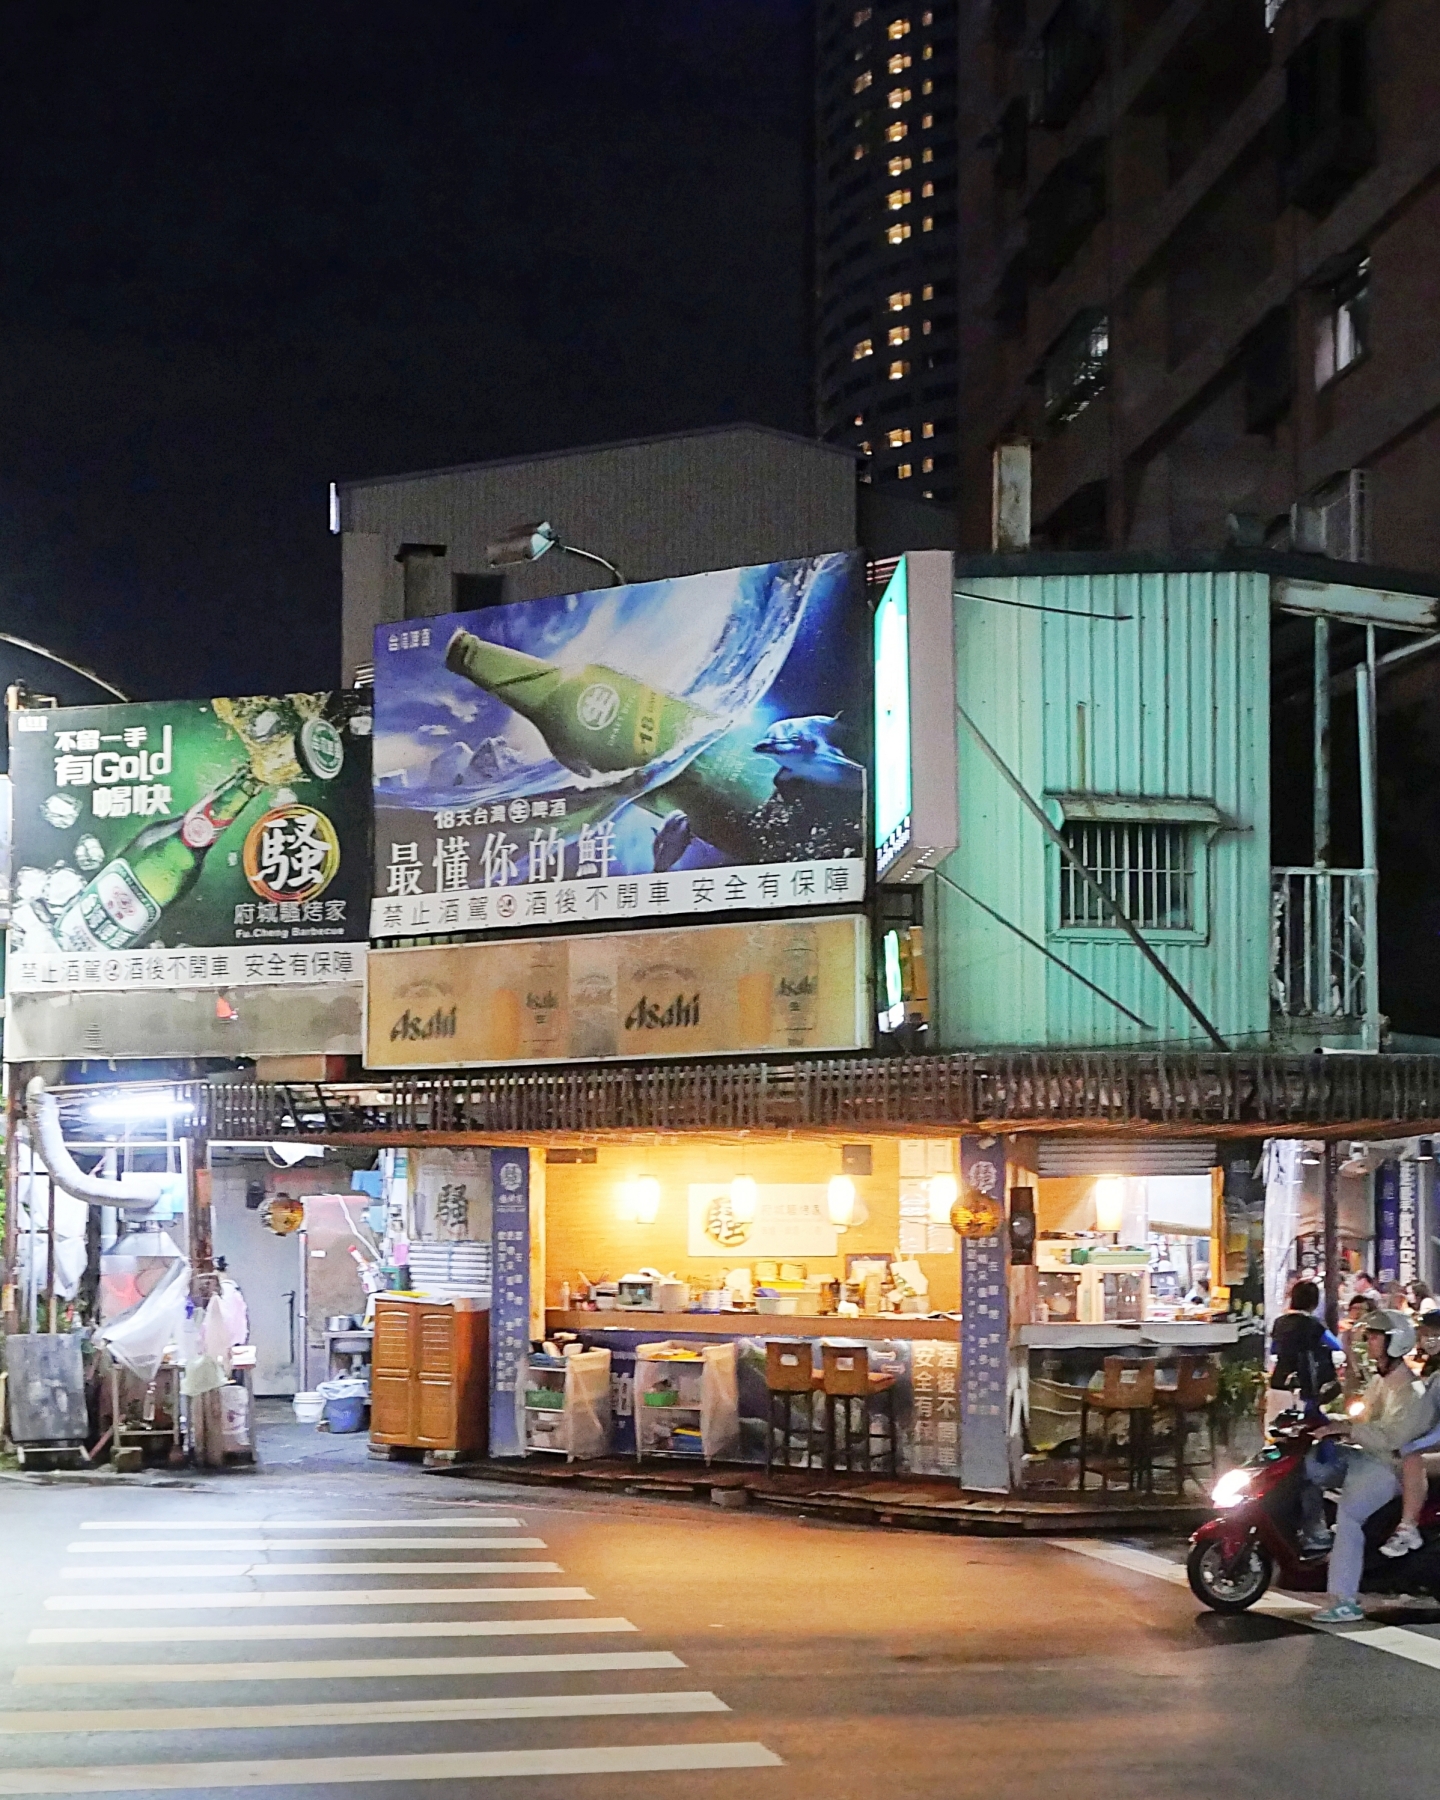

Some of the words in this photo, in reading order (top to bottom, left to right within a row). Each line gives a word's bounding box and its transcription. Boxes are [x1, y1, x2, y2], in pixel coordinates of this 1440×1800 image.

[54, 726, 147, 751] 不留一手
[250, 813, 332, 890] 騷
[386, 820, 617, 897] 最懂你的鮮
[383, 896, 488, 928] 禁止酒駕
[525, 880, 670, 916] 酒後不開車
[692, 866, 849, 904] 安全有保障
[125, 954, 230, 981] 酒後不開車
[245, 951, 354, 977] 安全有保障
[390, 1003, 457, 1042] Asahi
[624, 993, 700, 1031] Asahi
